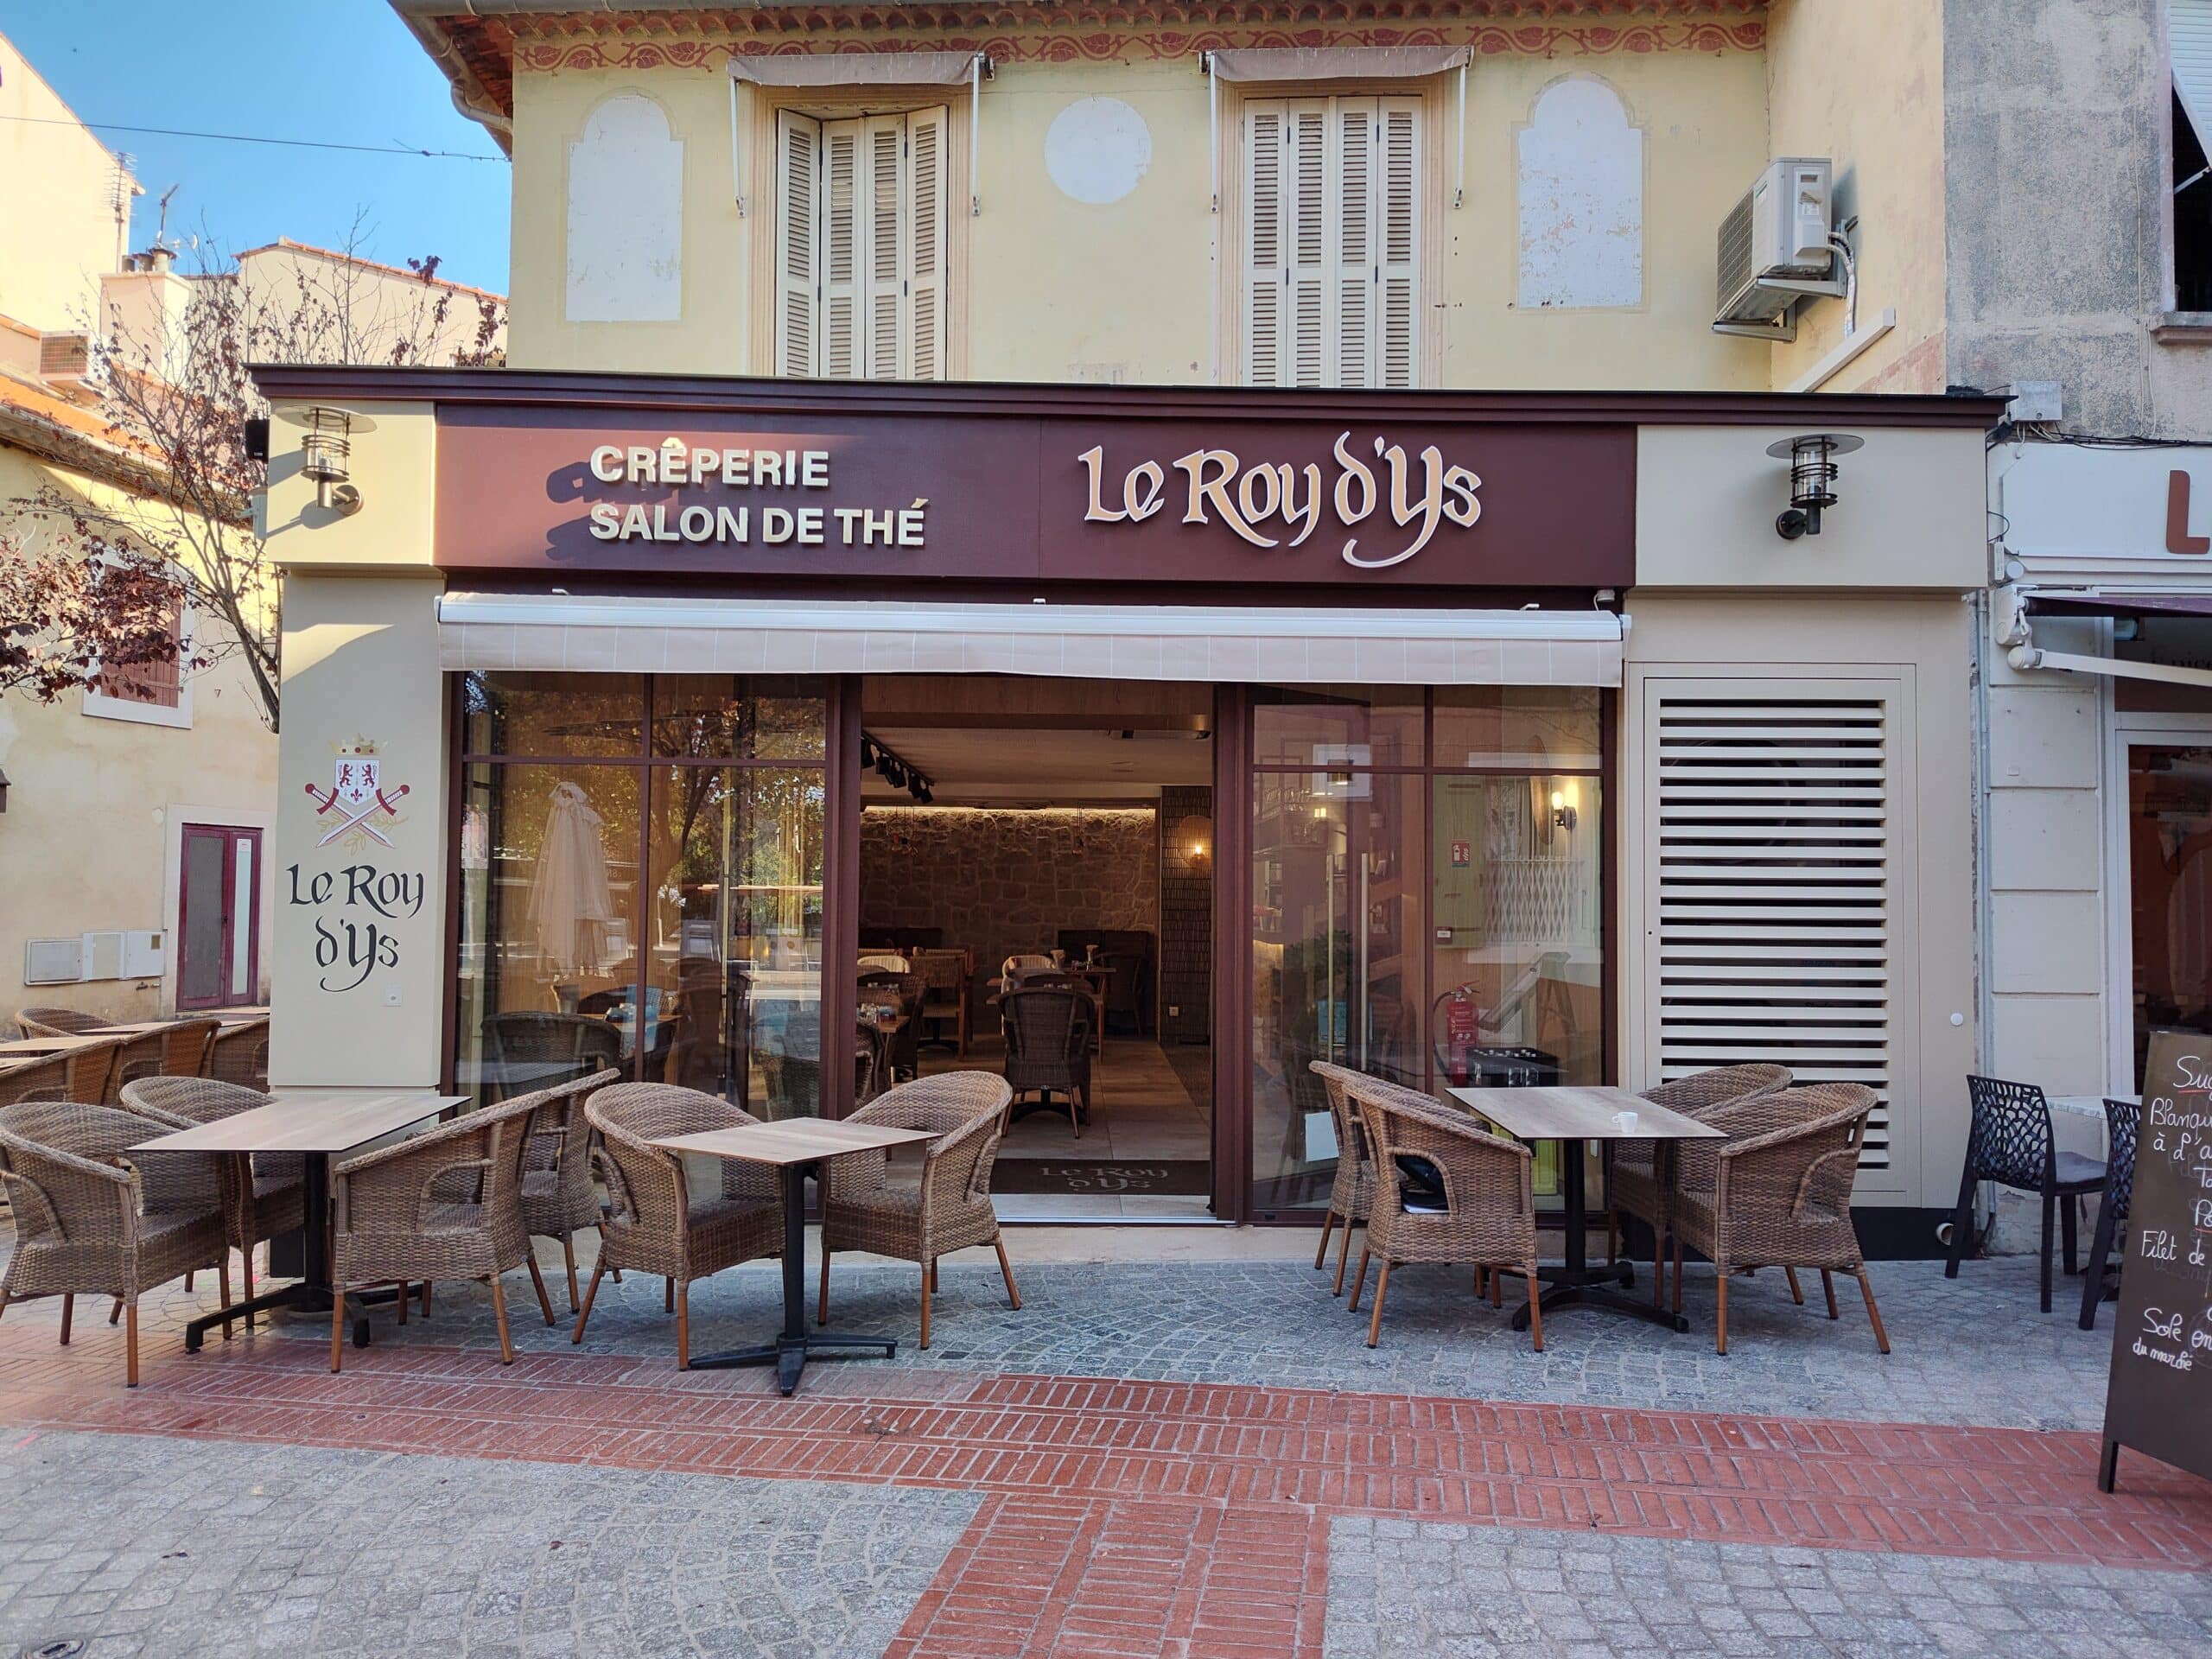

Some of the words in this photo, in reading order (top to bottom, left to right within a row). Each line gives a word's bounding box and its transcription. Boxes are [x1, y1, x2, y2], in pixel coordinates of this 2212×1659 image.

[589, 436, 830, 487] CRÊPERIE
[589, 504, 748, 543] SALON
[762, 507, 824, 544] DE
[834, 499, 930, 546] THÉ
[1077, 444, 1166, 523] Le
[1172, 448, 1321, 549] Roy
[1333, 430, 1483, 569] d'Ys
[286, 863, 334, 906] Le
[340, 864, 424, 919] Roy
[315, 915, 400, 993] d'Ys
[2141, 1230, 2177, 1261] Filet
[2189, 1237, 2205, 1266] de
[2133, 1336, 2148, 1356] du
[2142, 1307, 2183, 1342] Sole
